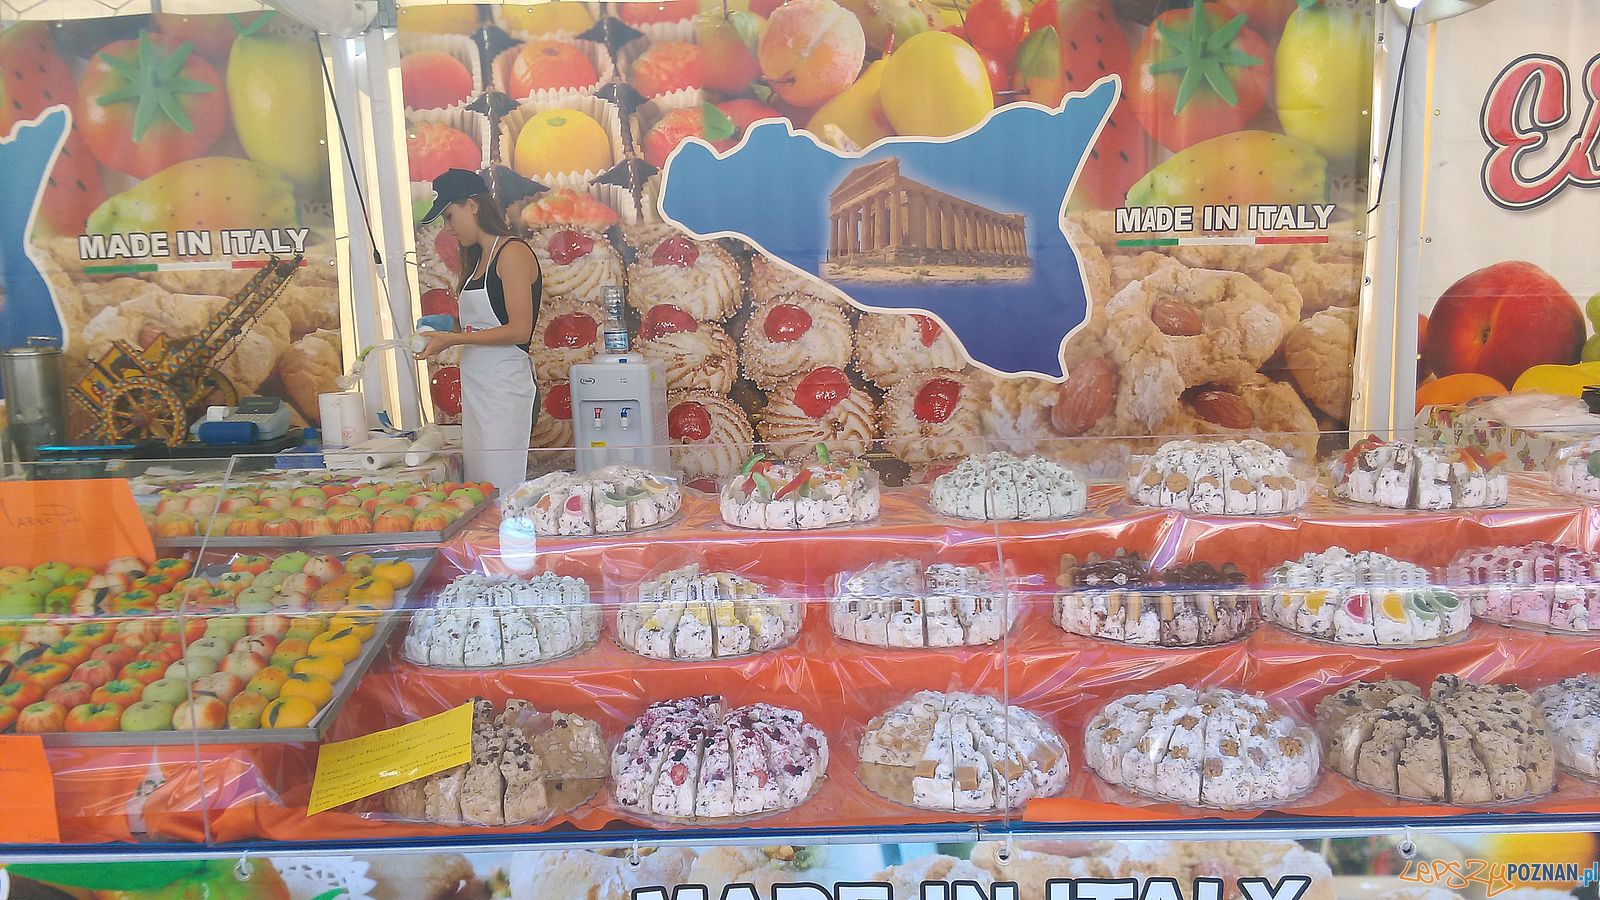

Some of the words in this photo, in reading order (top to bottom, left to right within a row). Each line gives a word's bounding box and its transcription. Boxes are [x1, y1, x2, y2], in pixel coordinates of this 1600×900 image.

[1115, 206, 1194, 233] MADE
[1203, 204, 1238, 231] IN
[1248, 204, 1336, 230] ITALY
[78, 231, 170, 260] MADE
[176, 230, 212, 256] IN
[222, 228, 310, 255] ITALY
